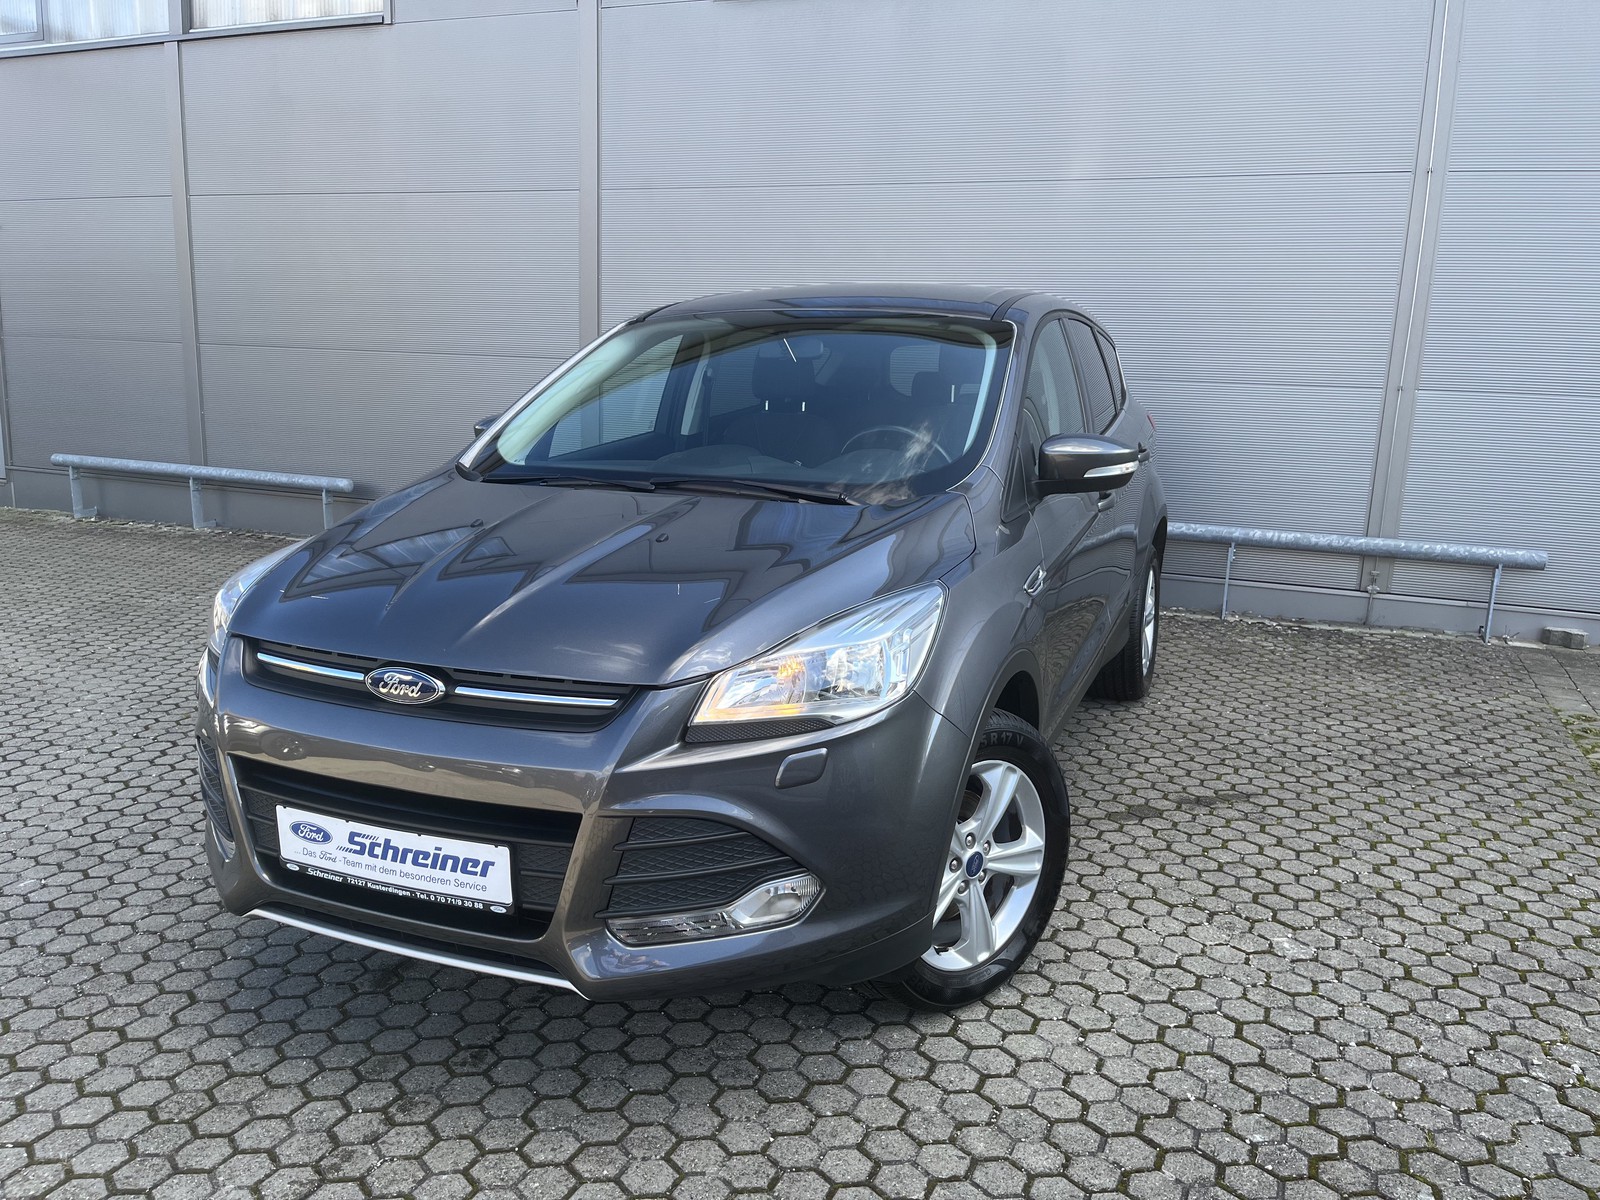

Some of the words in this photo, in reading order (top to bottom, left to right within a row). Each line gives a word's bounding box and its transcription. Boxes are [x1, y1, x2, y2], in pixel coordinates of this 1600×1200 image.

[379, 672, 422, 698] Ford
[990, 732, 999, 745] R
[1001, 731, 1013, 744] 17
[298, 822, 324, 842] Ford
[302, 847, 317, 859] Das
[319, 850, 338, 863] Ford
[364, 863, 377, 872] mit
[379, 865, 397, 876] dem
[399, 869, 451, 886] besonderen
[453, 878, 488, 892] Service
[348, 830, 496, 878] Schreiner
[306, 867, 343, 882] Schreiner
[346, 877, 366, 887] 72127
[367, 882, 411, 896] Kusterdingen
[416, 891, 429, 900] Tel.
[436, 895, 446, 903] 70
[447, 897, 462, 905] 71/9
[463, 900, 473, 908] 30
